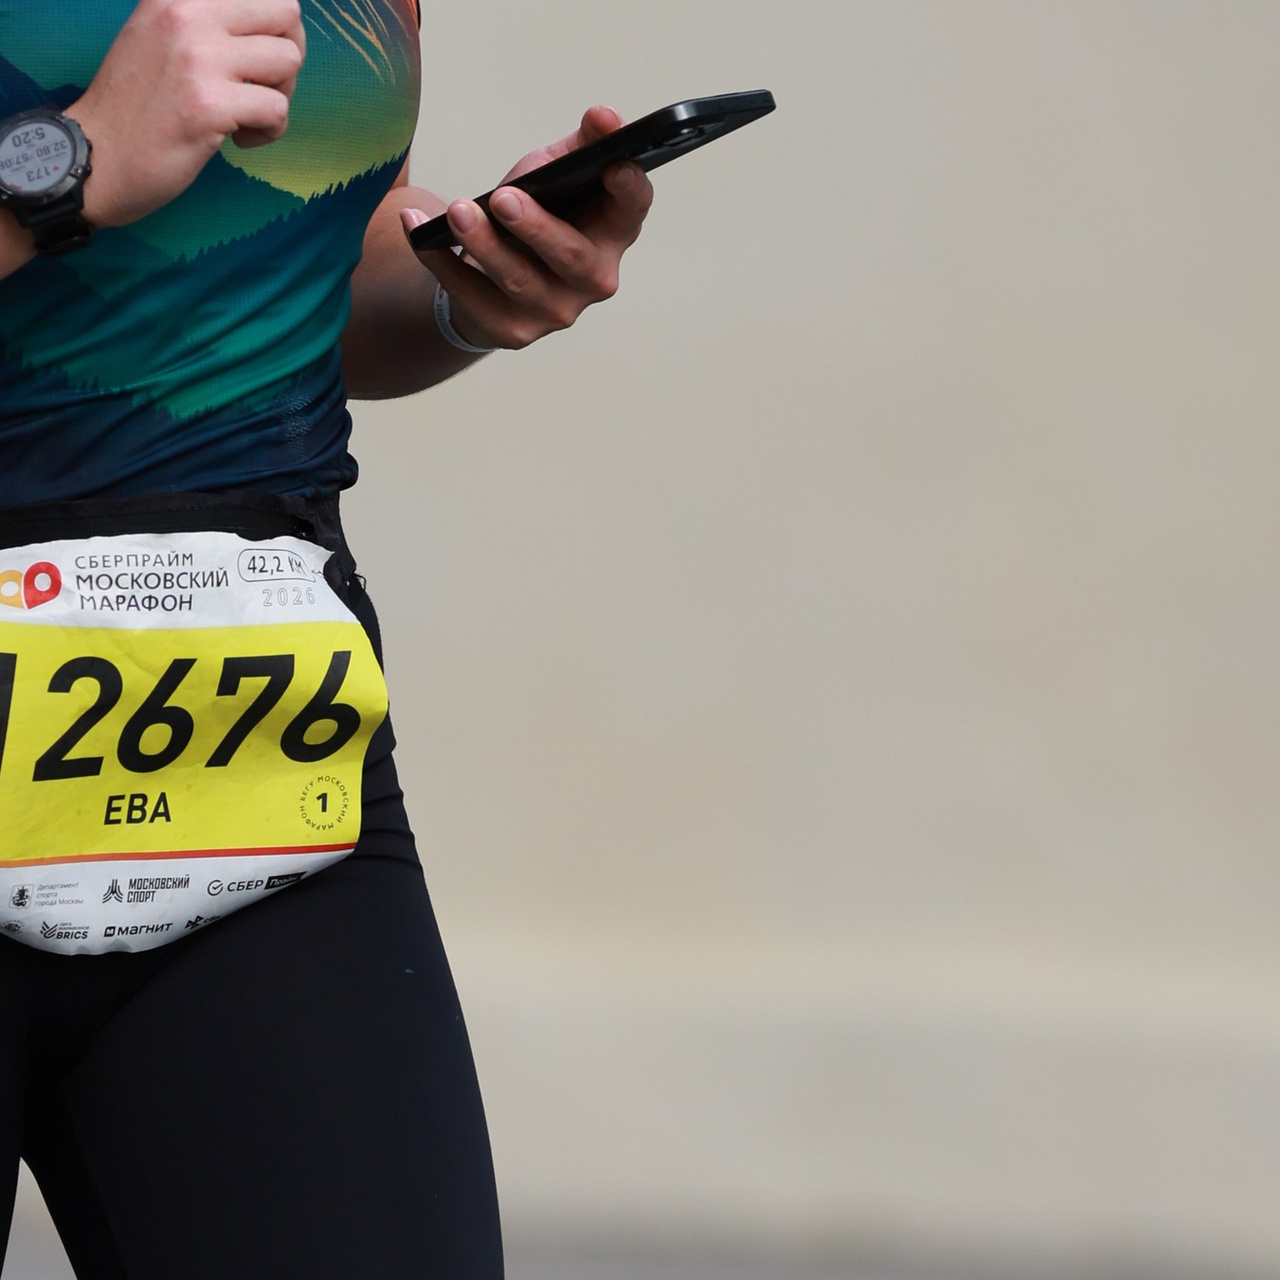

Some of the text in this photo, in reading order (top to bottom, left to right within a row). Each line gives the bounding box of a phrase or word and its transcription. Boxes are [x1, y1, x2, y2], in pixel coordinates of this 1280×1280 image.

[11, 127, 46, 148] 5:20
[75, 551, 193, 569] СБЕРПРАЙМ
[247, 556, 284, 575] 42,2
[76, 567, 229, 590] МОСКОВСКИЙ
[80, 594, 193, 611] МАРАФОН
[103, 792, 172, 825] ЕВА
[316, 792, 328, 813] 1
[128, 874, 190, 890] МОСКОВСКИЙ
[227, 880, 263, 892] СБЕР
[127, 890, 157, 903] СПОРТ
[56, 931, 88, 940] BRICS
